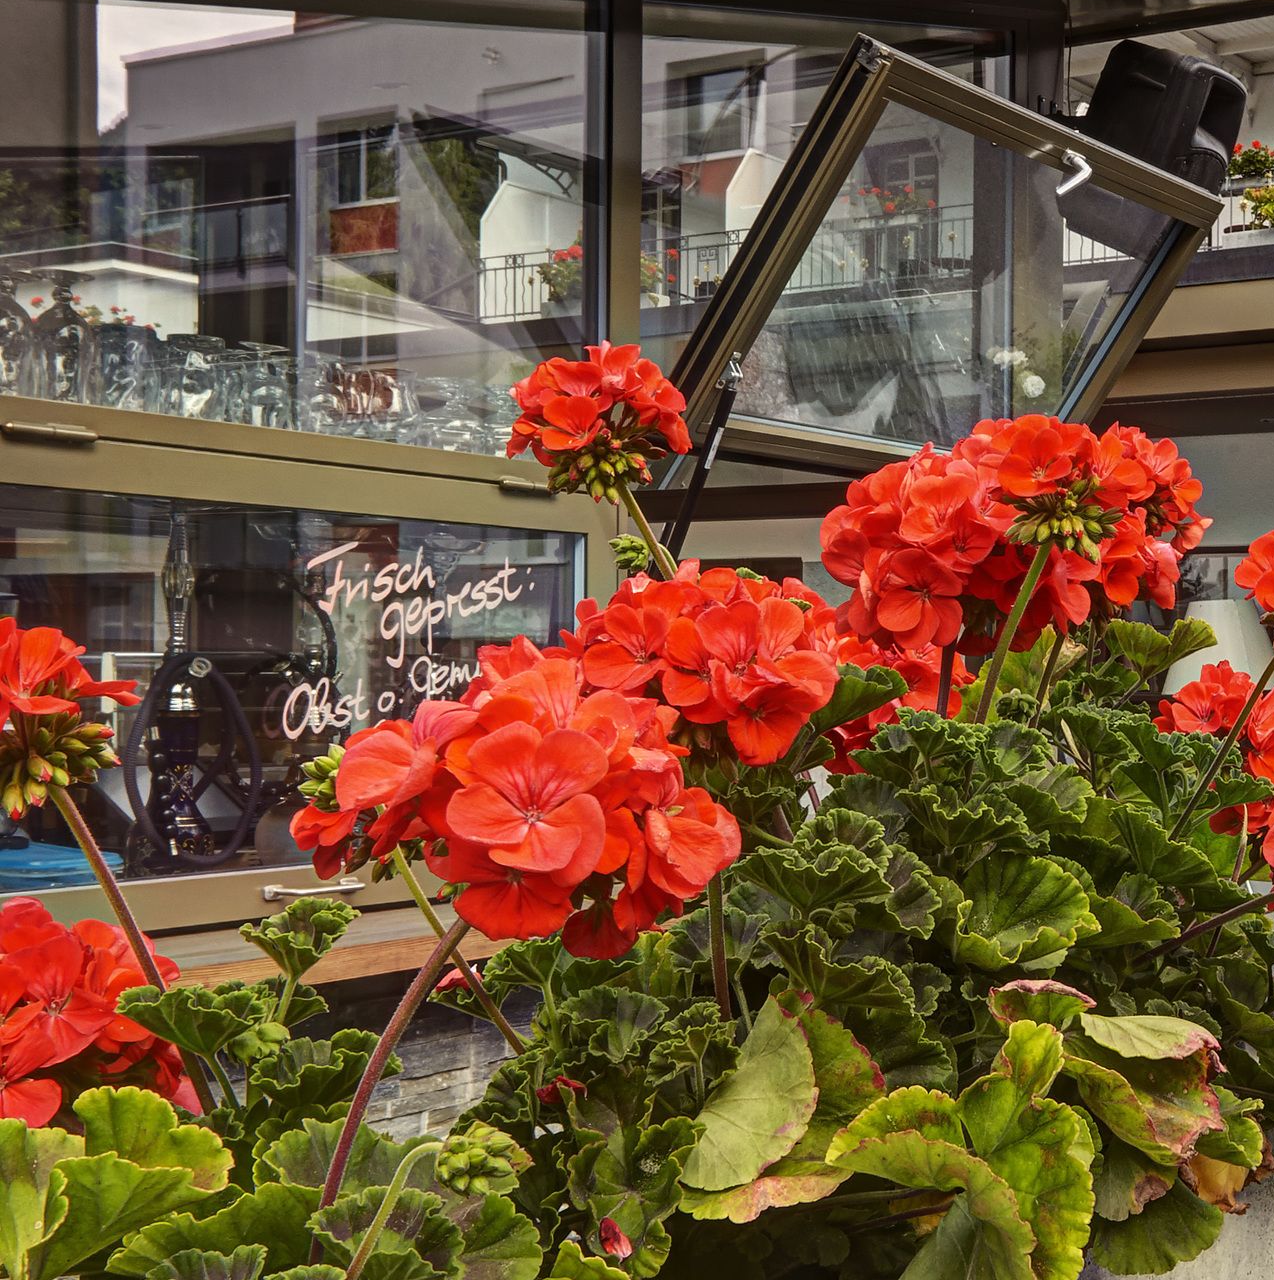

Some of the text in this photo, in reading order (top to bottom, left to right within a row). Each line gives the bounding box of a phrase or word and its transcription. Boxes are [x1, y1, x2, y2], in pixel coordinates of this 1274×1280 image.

[306, 541, 436, 616] Frisch
[380, 556, 535, 668] gepresst:
[283, 677, 370, 740] Obst
